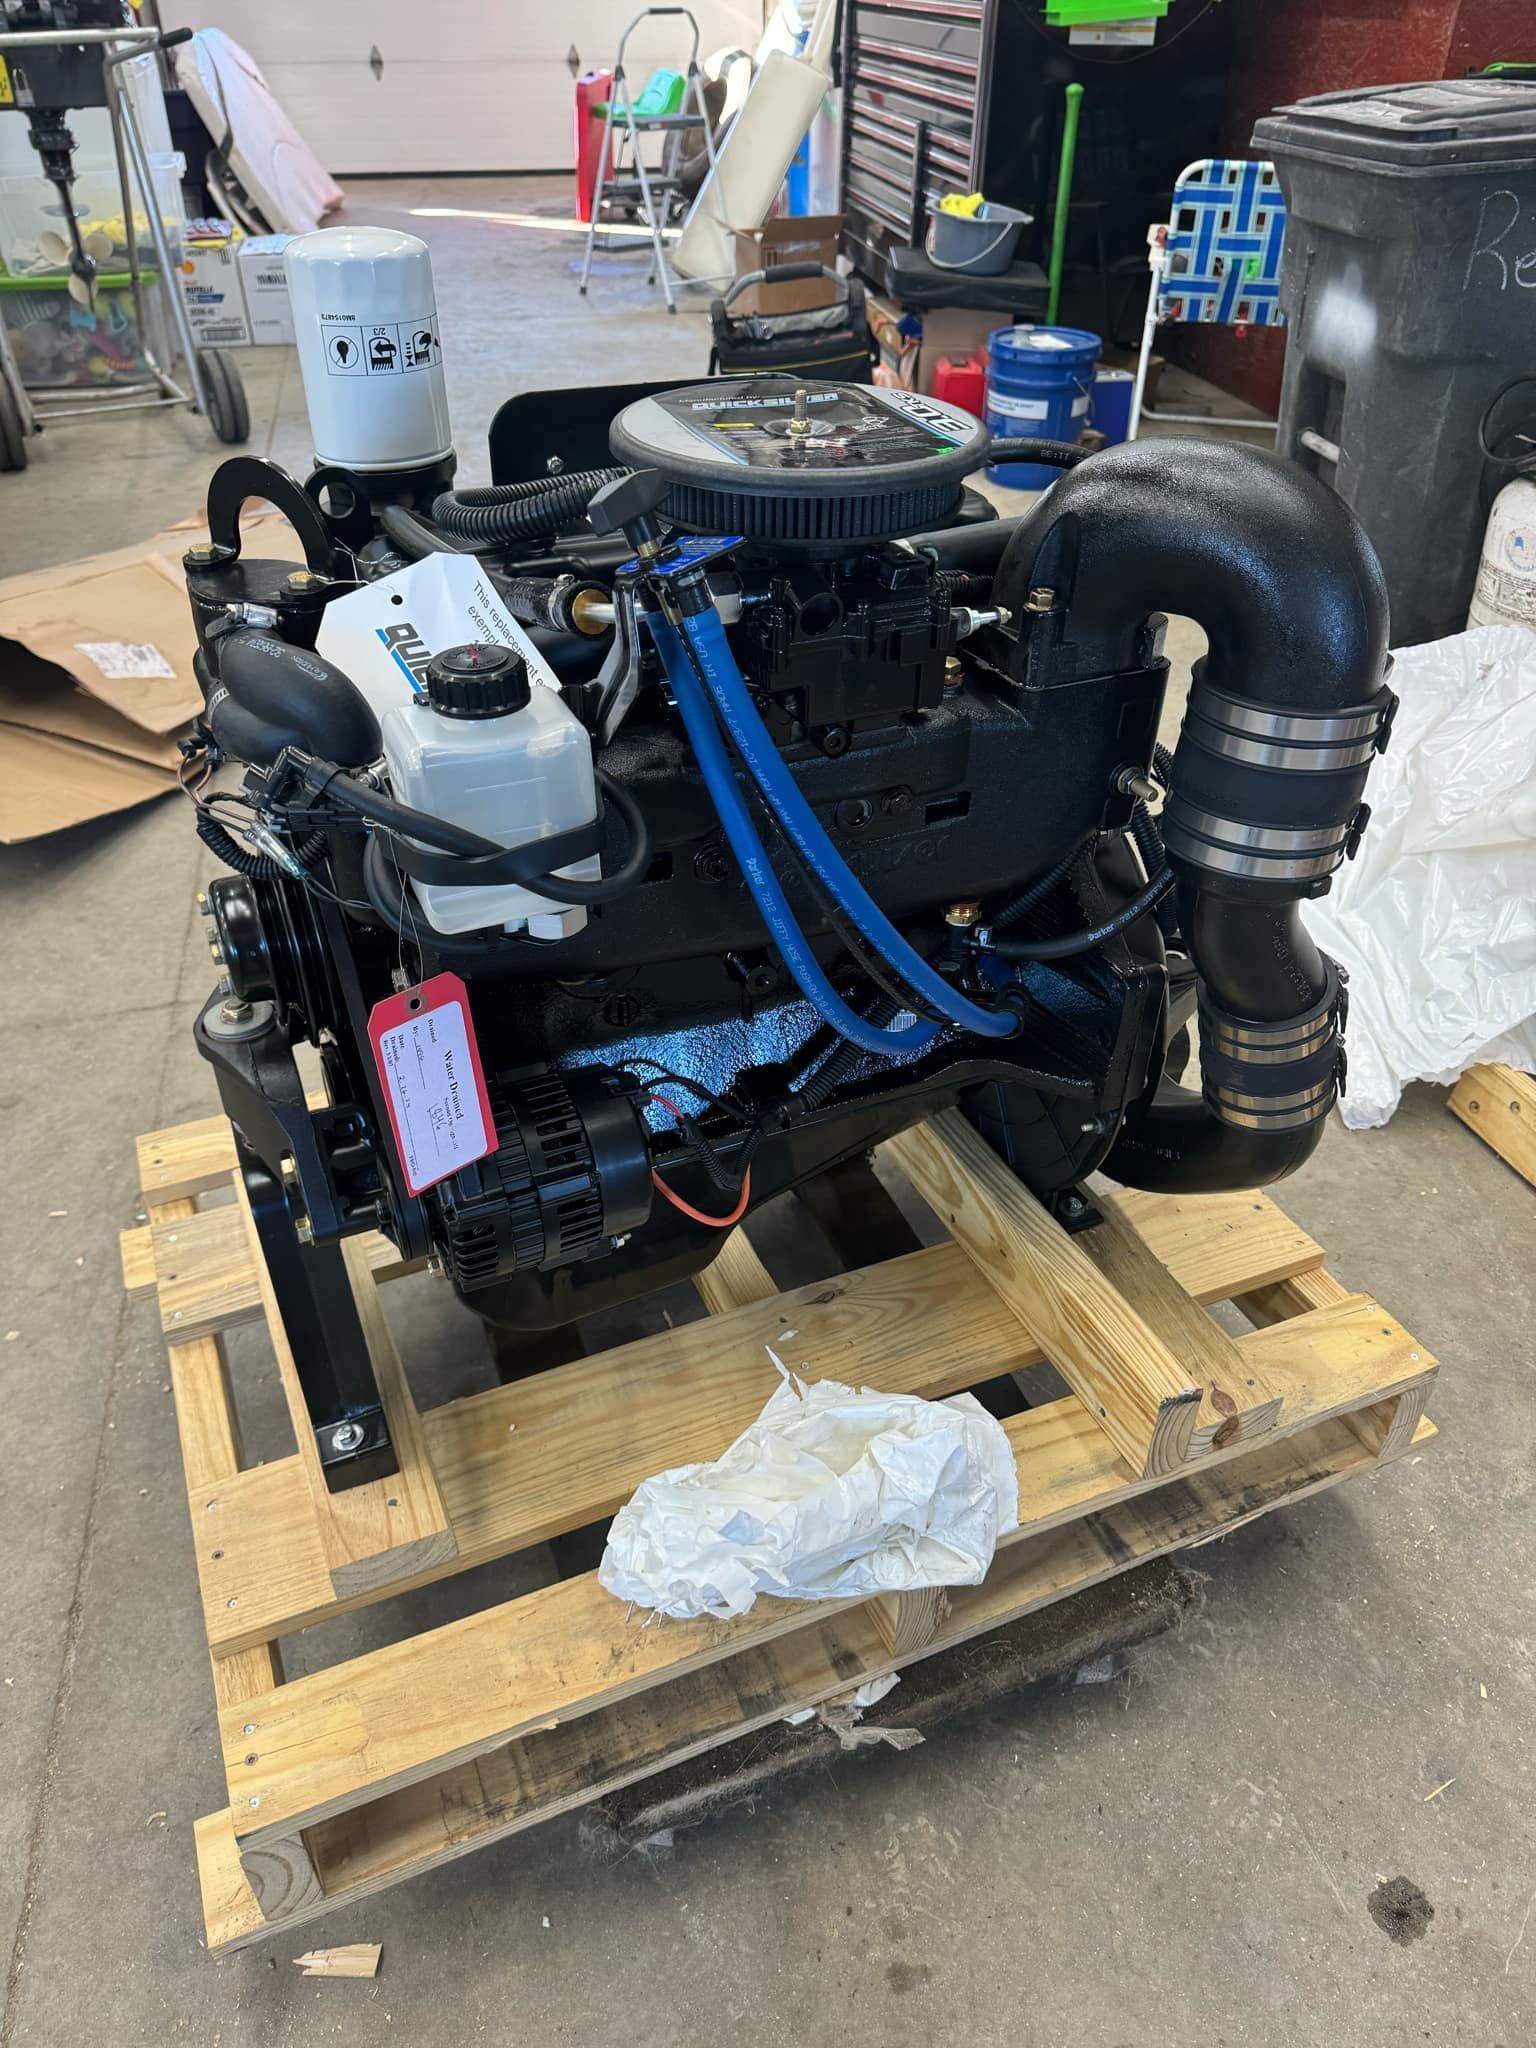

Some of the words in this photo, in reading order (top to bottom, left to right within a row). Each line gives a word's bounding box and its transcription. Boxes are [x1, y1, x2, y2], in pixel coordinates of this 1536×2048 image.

[373, 327, 386, 336] 2/3
[468, 605, 499, 646] exempt
[472, 580, 490, 609] This
[489, 608, 539, 678] replacement
[694, 636, 709, 658] USA
[704, 664, 717, 678] IN
[712, 685, 733, 713] MADE
[1088, 923, 1115, 941] Parker
[1120, 905, 1139, 923] 7212
[1143, 882, 1164, 905] JIFFY
[745, 857, 766, 886] Parker
[760, 892, 777, 913] 7212
[771, 916, 791, 942] JIFFY
[785, 940, 801, 962] HOSE
[798, 965, 819, 996] PUSH-ON
[428, 1018, 437, 1043] Drained
[390, 1036, 400, 1064] Drained:
[444, 1049, 455, 1080] Water
[449, 1081, 464, 1121] Drained
